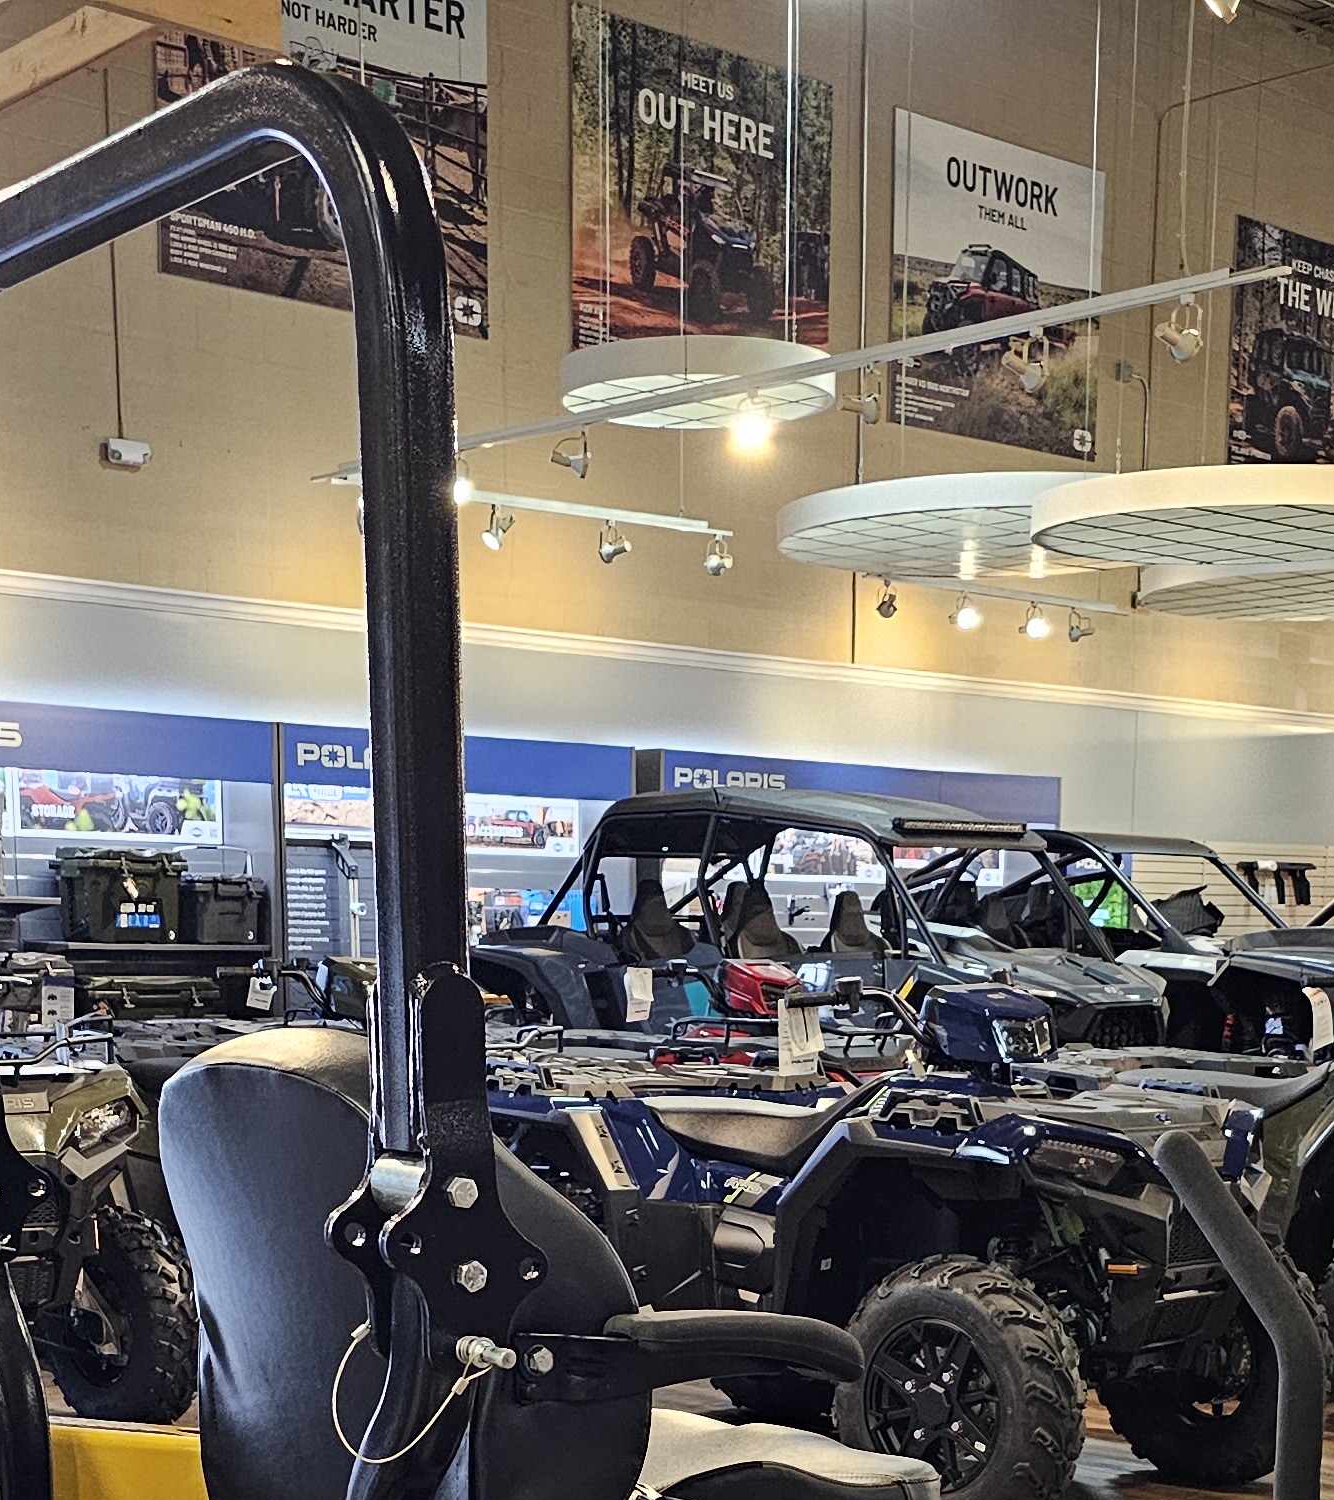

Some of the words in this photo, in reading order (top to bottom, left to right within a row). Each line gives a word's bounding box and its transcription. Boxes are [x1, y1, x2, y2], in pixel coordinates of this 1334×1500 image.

[281, 0, 311, 22] NOT
[681, 70, 715, 95] MEET
[717, 79, 734, 101] US
[638, 88, 695, 135] OUT
[703, 105, 775, 160] HERE
[947, 156, 1059, 217] OUTWORK
[169, 211, 222, 232] SPORTSMAN
[978, 204, 1005, 225] THEM
[1007, 213, 1027, 231] ALL
[1292, 258, 1313, 275] KEEP
[1277, 275, 1312, 313] THE
[674, 766, 786, 792] POLARIS
[31, 803, 76, 819] STORAGE
